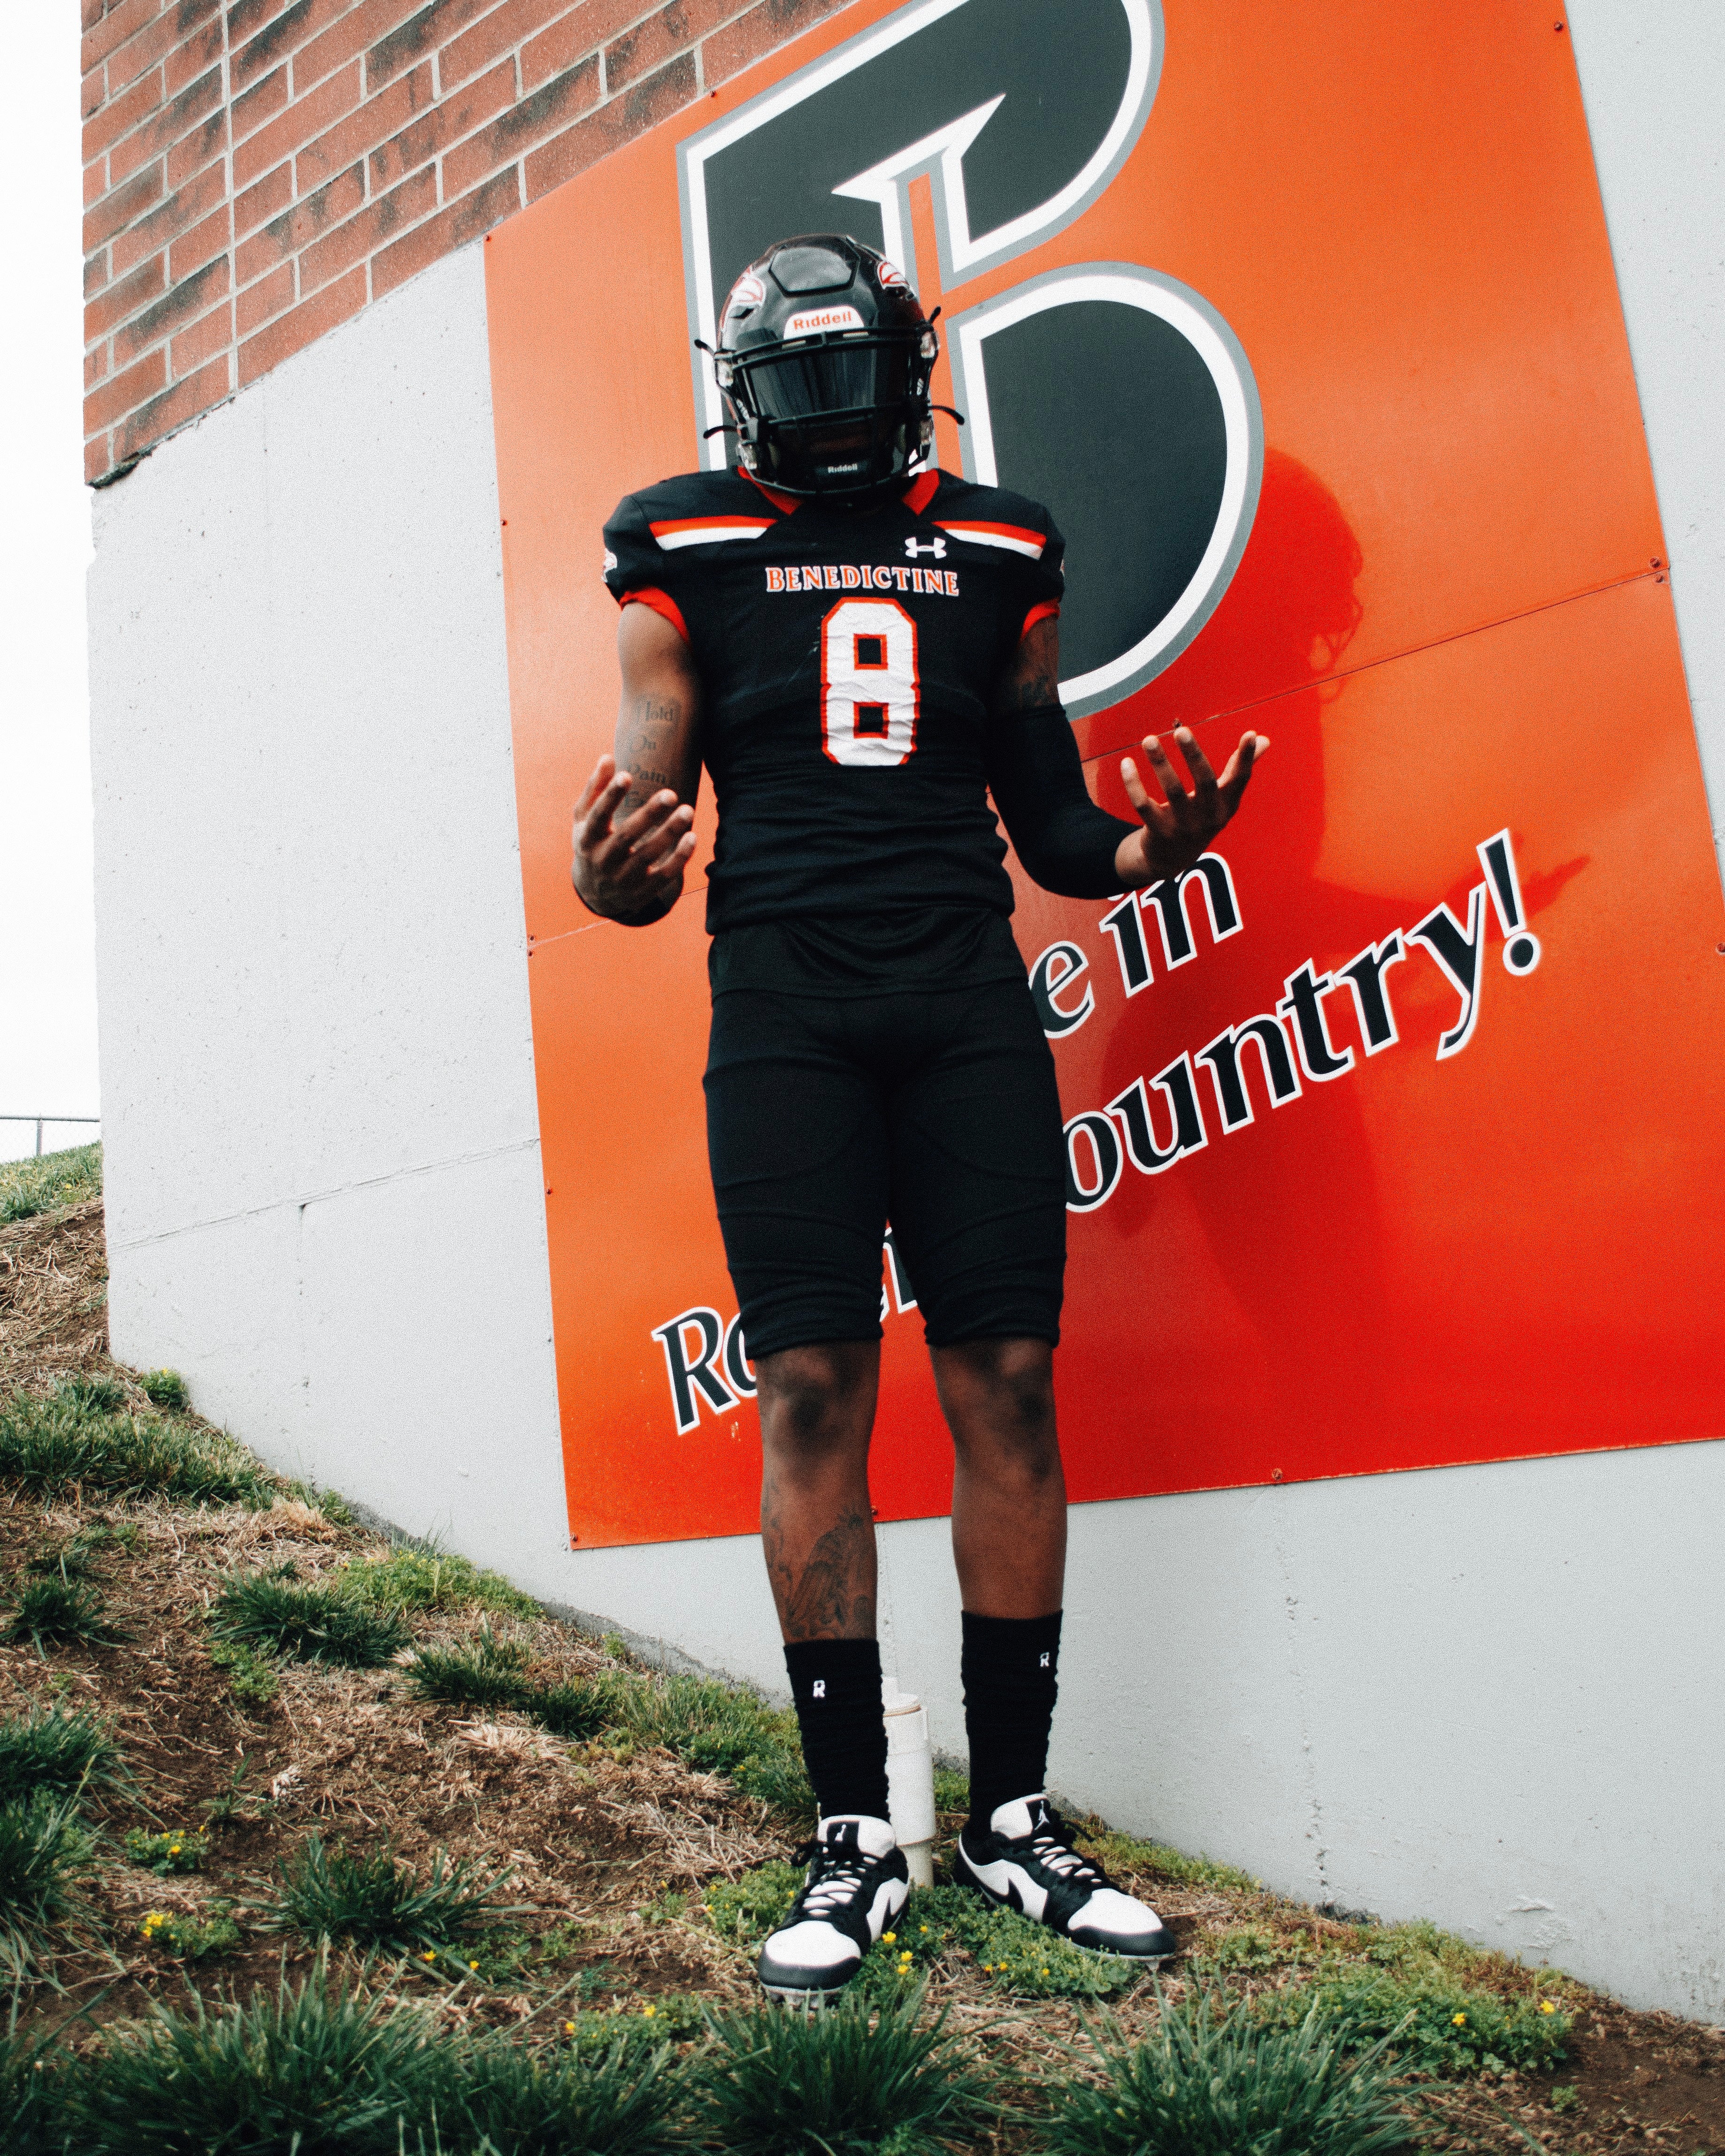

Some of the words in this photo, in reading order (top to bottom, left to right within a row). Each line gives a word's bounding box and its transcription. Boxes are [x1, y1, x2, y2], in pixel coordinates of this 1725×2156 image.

[793, 310, 851, 330] Riddell
[828, 463, 858, 474] Riddell
[766, 565, 960, 596] BENEDICTINE
[820, 596, 920, 766] 8
[1099, 851, 1243, 999] in
[1062, 827, 1541, 1213] ountry!
